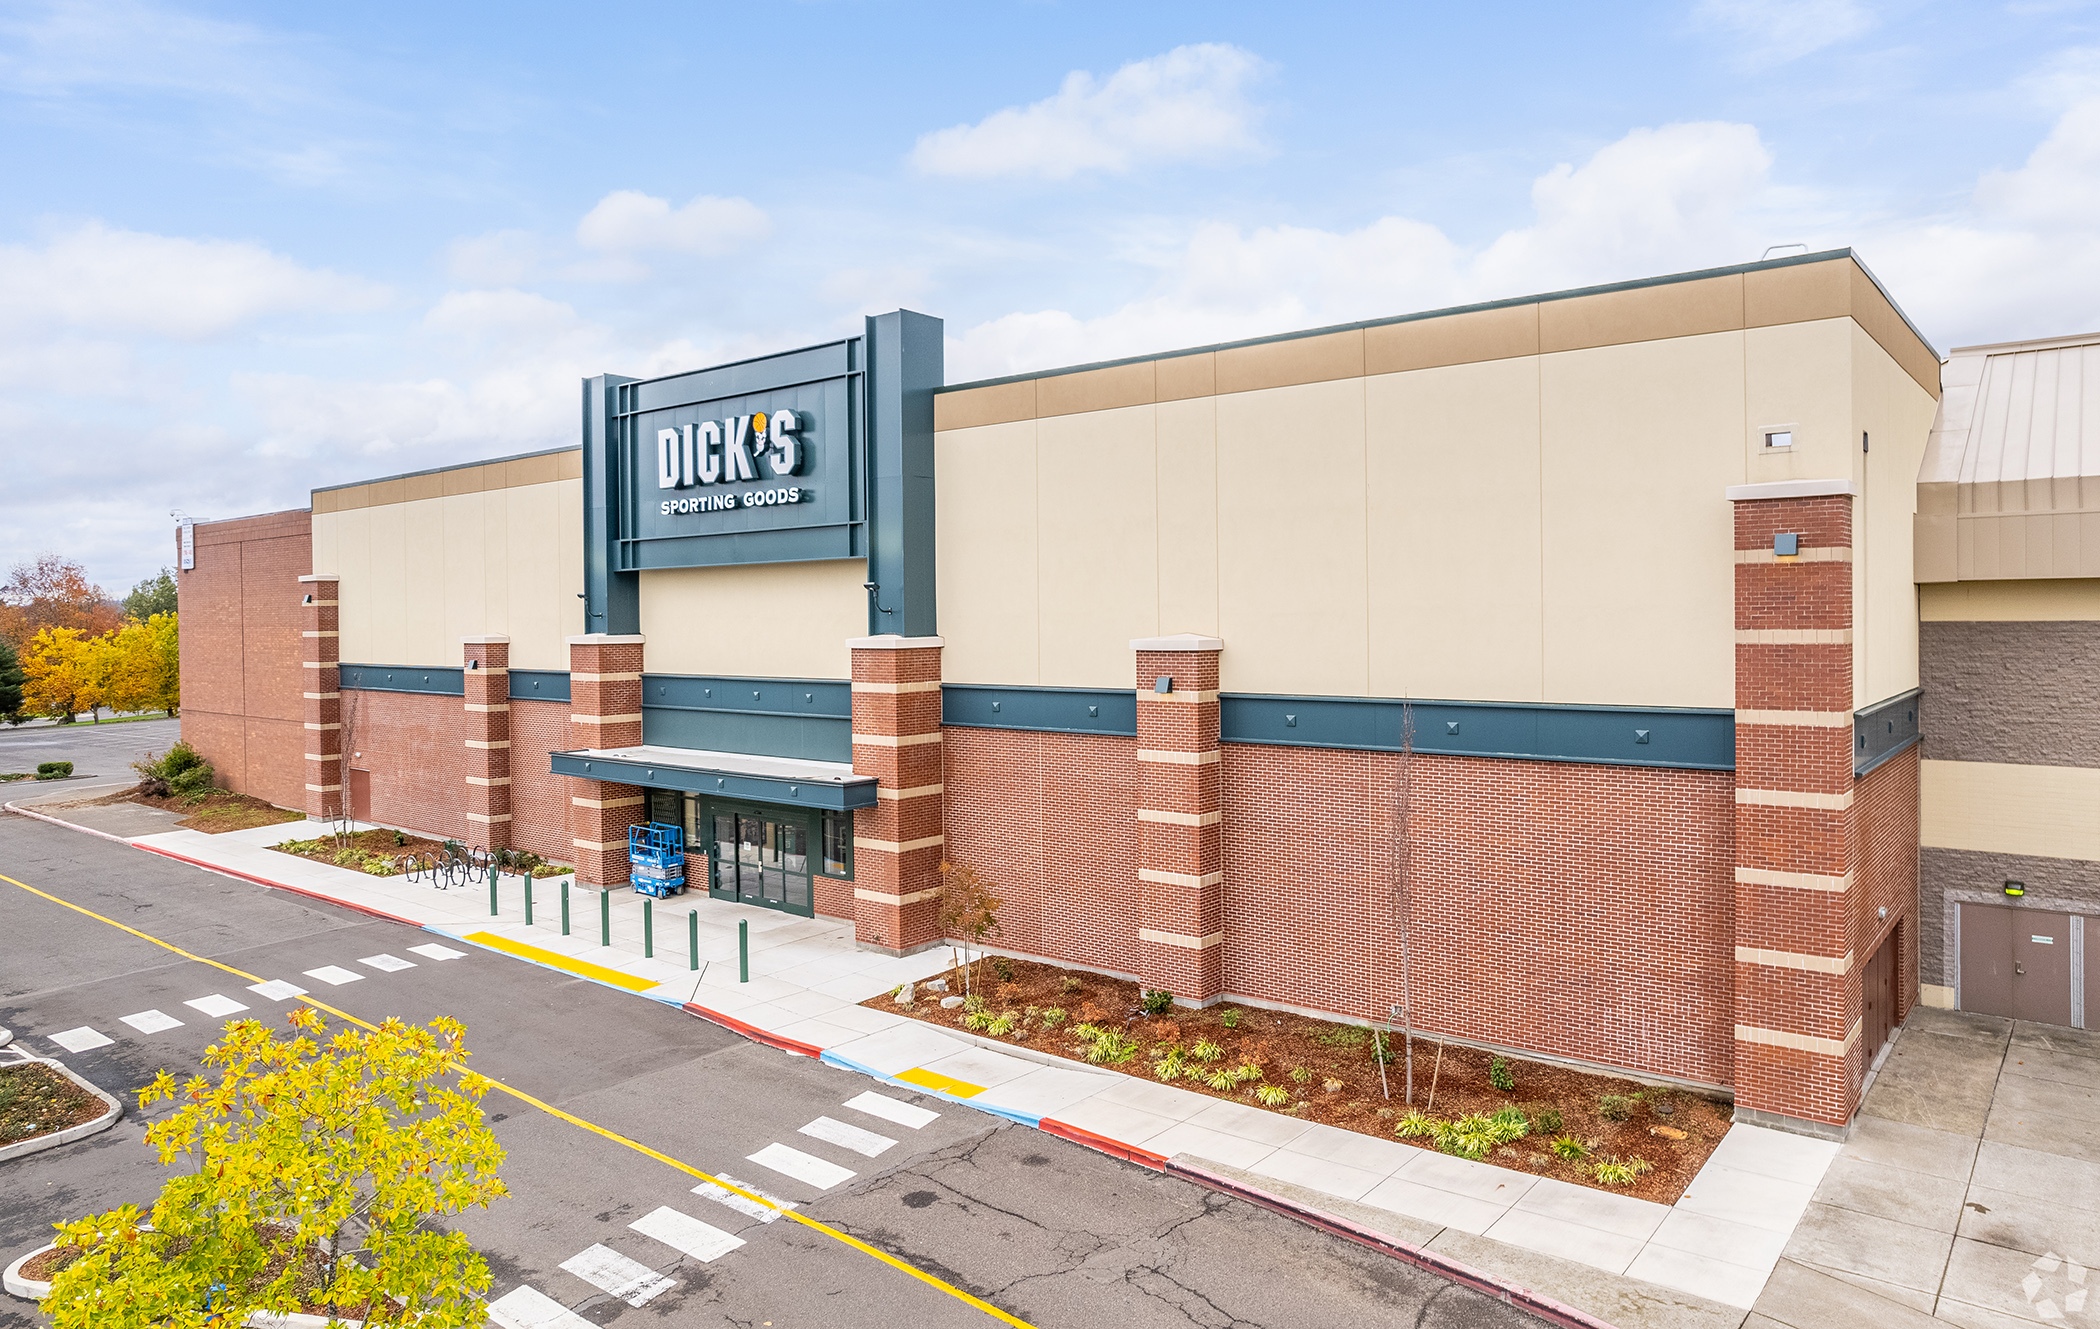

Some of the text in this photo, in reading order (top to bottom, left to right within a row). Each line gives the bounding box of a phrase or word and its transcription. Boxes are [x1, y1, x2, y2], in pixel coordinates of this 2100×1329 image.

[658, 409, 800, 489] DICK'S
[661, 487, 799, 515] SPORTING GOODS
